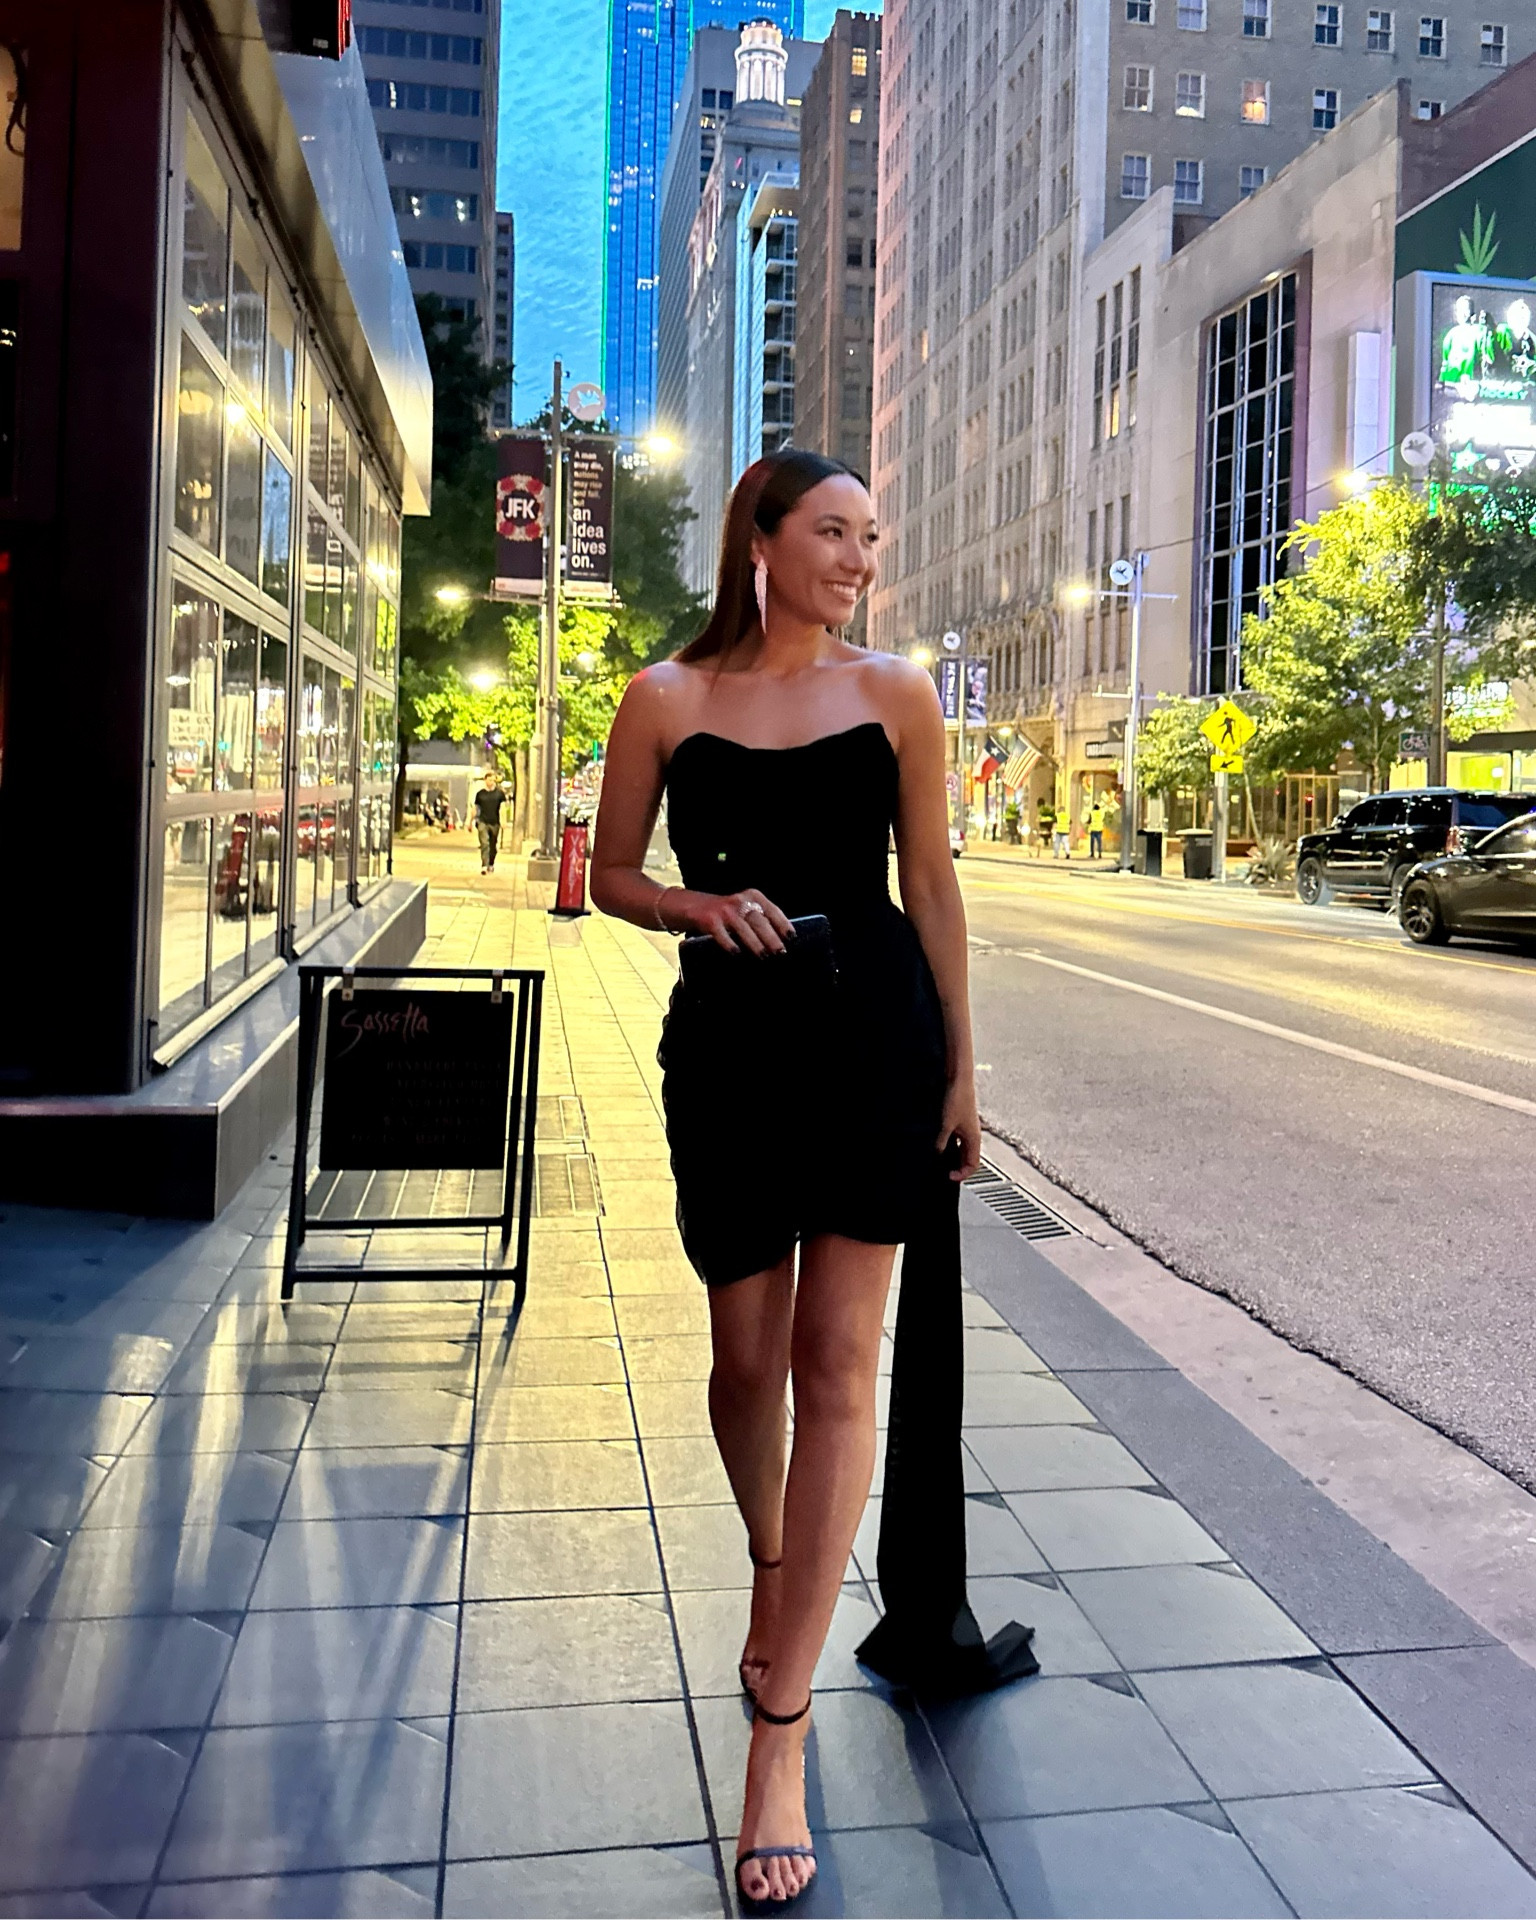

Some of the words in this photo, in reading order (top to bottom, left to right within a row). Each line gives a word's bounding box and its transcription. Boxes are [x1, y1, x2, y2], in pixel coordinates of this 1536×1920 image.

[505, 498, 536, 519] JFK
[573, 508, 592, 522] an
[572, 522, 605, 539] idea
[572, 539, 607, 555] lives
[571, 555, 595, 569] on.
